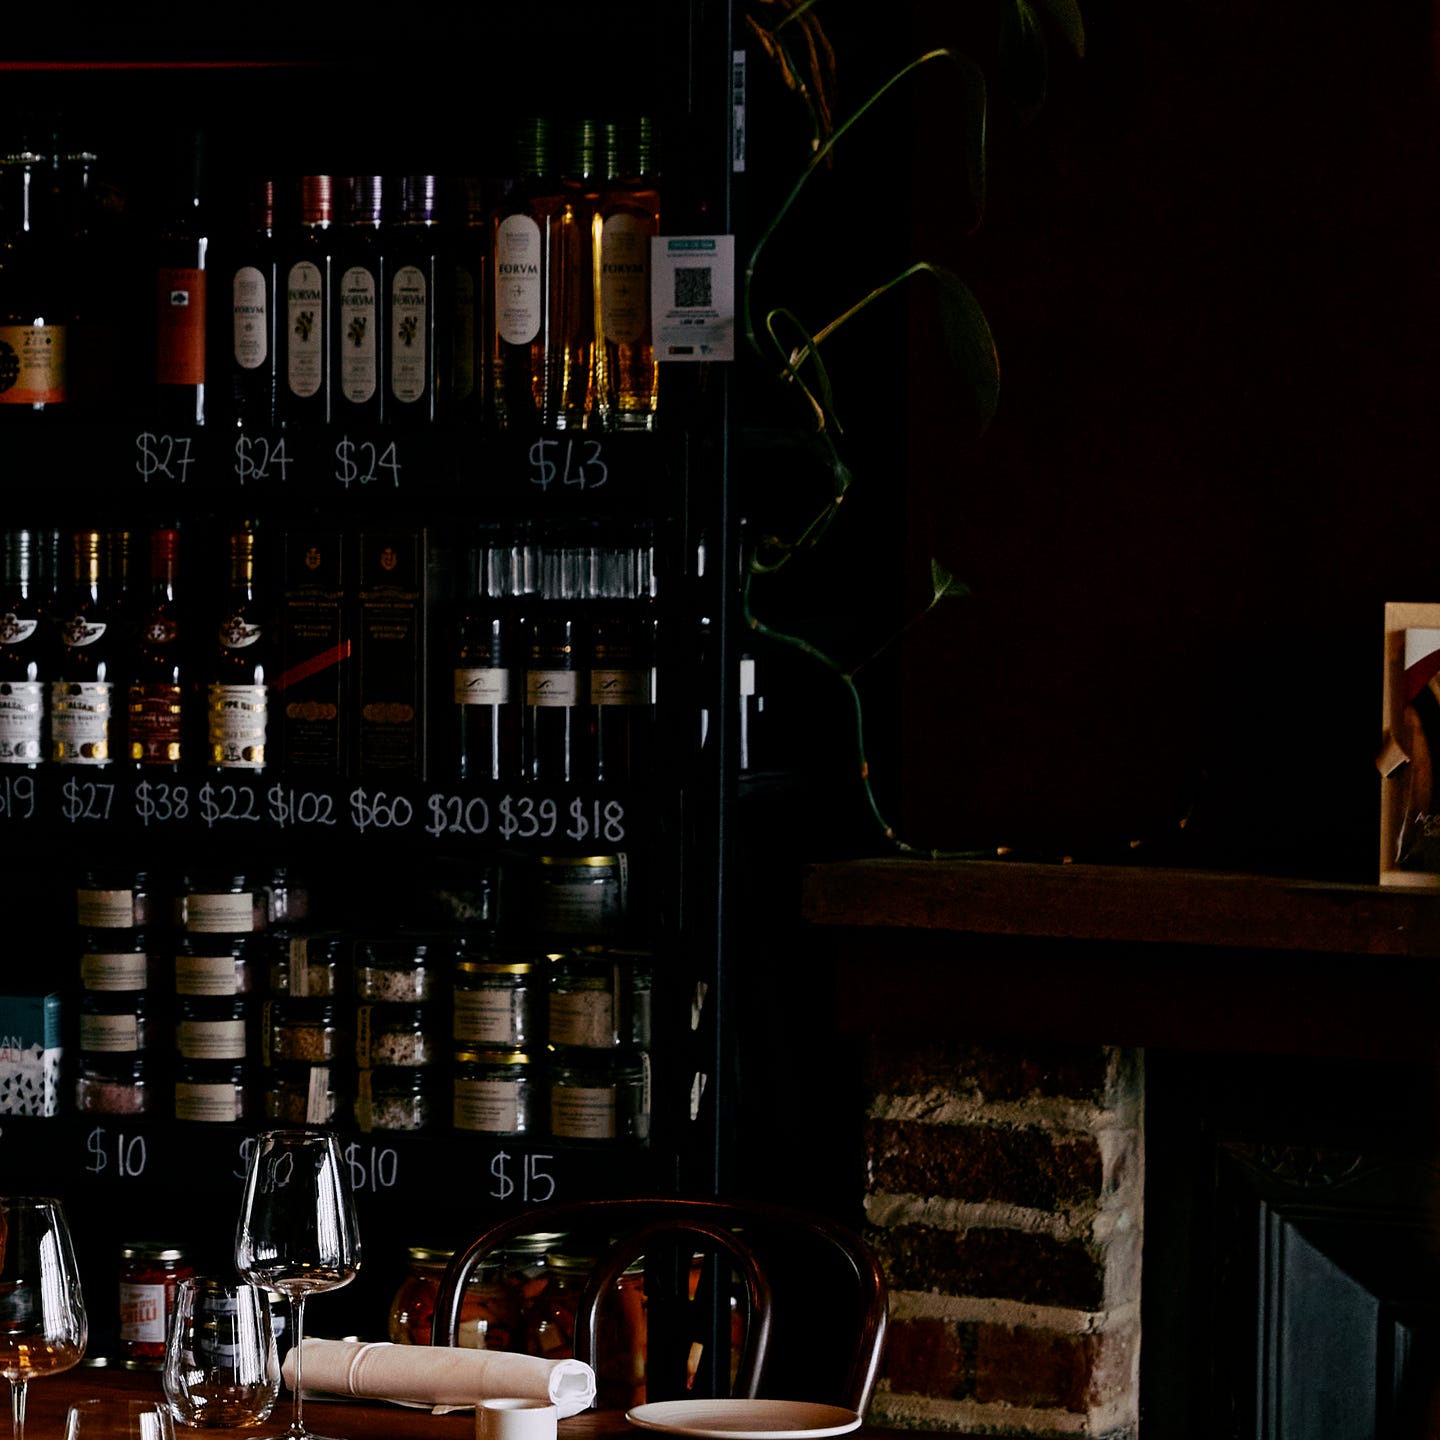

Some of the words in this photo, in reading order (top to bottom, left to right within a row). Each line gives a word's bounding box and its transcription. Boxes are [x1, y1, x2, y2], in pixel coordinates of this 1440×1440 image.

[135, 431, 196, 484] $27
[233, 431, 294, 486] $24
[335, 434, 402, 489] $24
[527, 436, 609, 492] $43
[61, 775, 115, 823] $27
[134, 779, 189, 826] $38
[198, 781, 261, 828] $22
[266, 782, 337, 829] $102
[349, 785, 413, 834] $60
[424, 793, 490, 838] $20
[498, 794, 558, 841] $39
[566, 796, 625, 843] $18
[85, 1126, 147, 1176] $10
[345, 1142, 399, 1193] $10
[489, 1150, 557, 1203] $15
